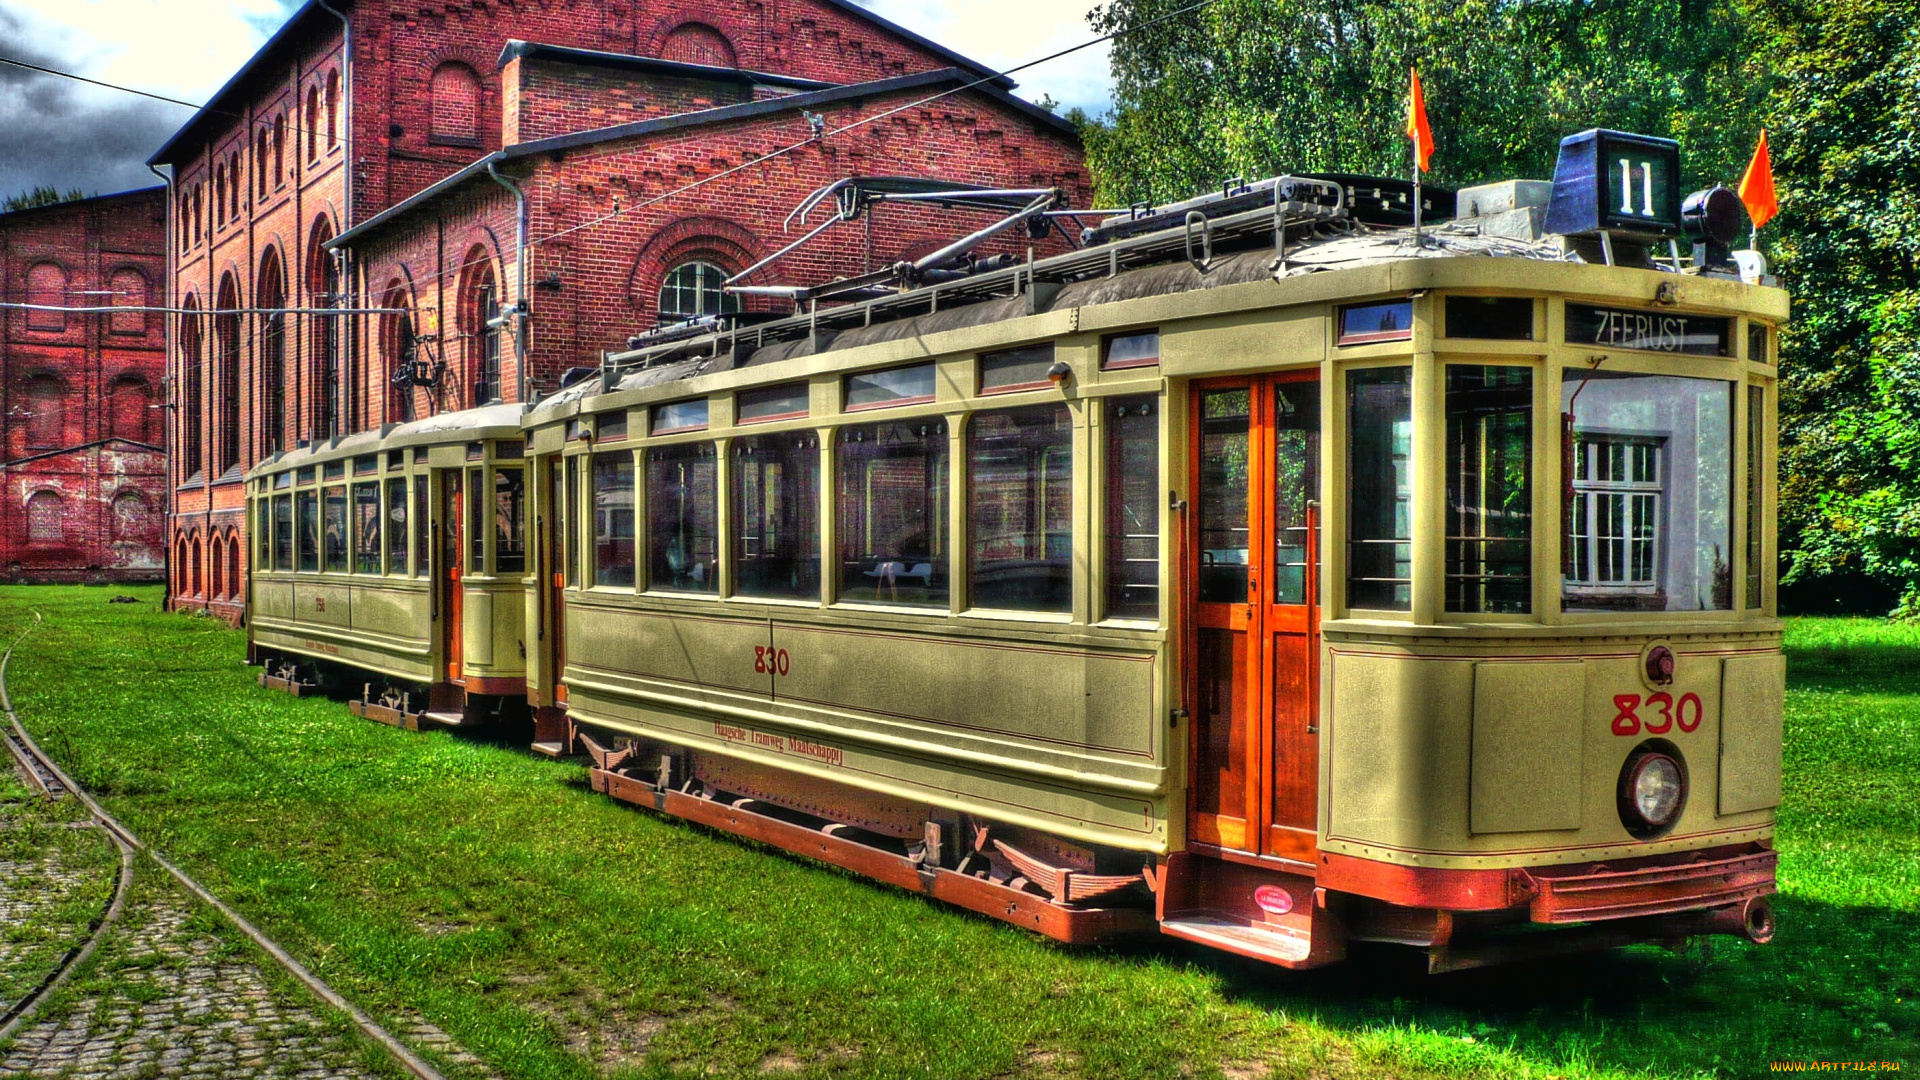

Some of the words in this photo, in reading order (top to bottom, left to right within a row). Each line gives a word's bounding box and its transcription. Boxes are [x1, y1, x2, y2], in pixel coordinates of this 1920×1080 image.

[1619, 158, 1655, 216] 11
[1594, 310, 1688, 352] ZEERUST
[754, 645, 790, 677] 830
[1611, 691, 1703, 736] 830
[714, 720, 746, 742] Haagsche
[750, 727, 784, 753] Tramweg
[788, 735, 843, 766] Maatschappij
